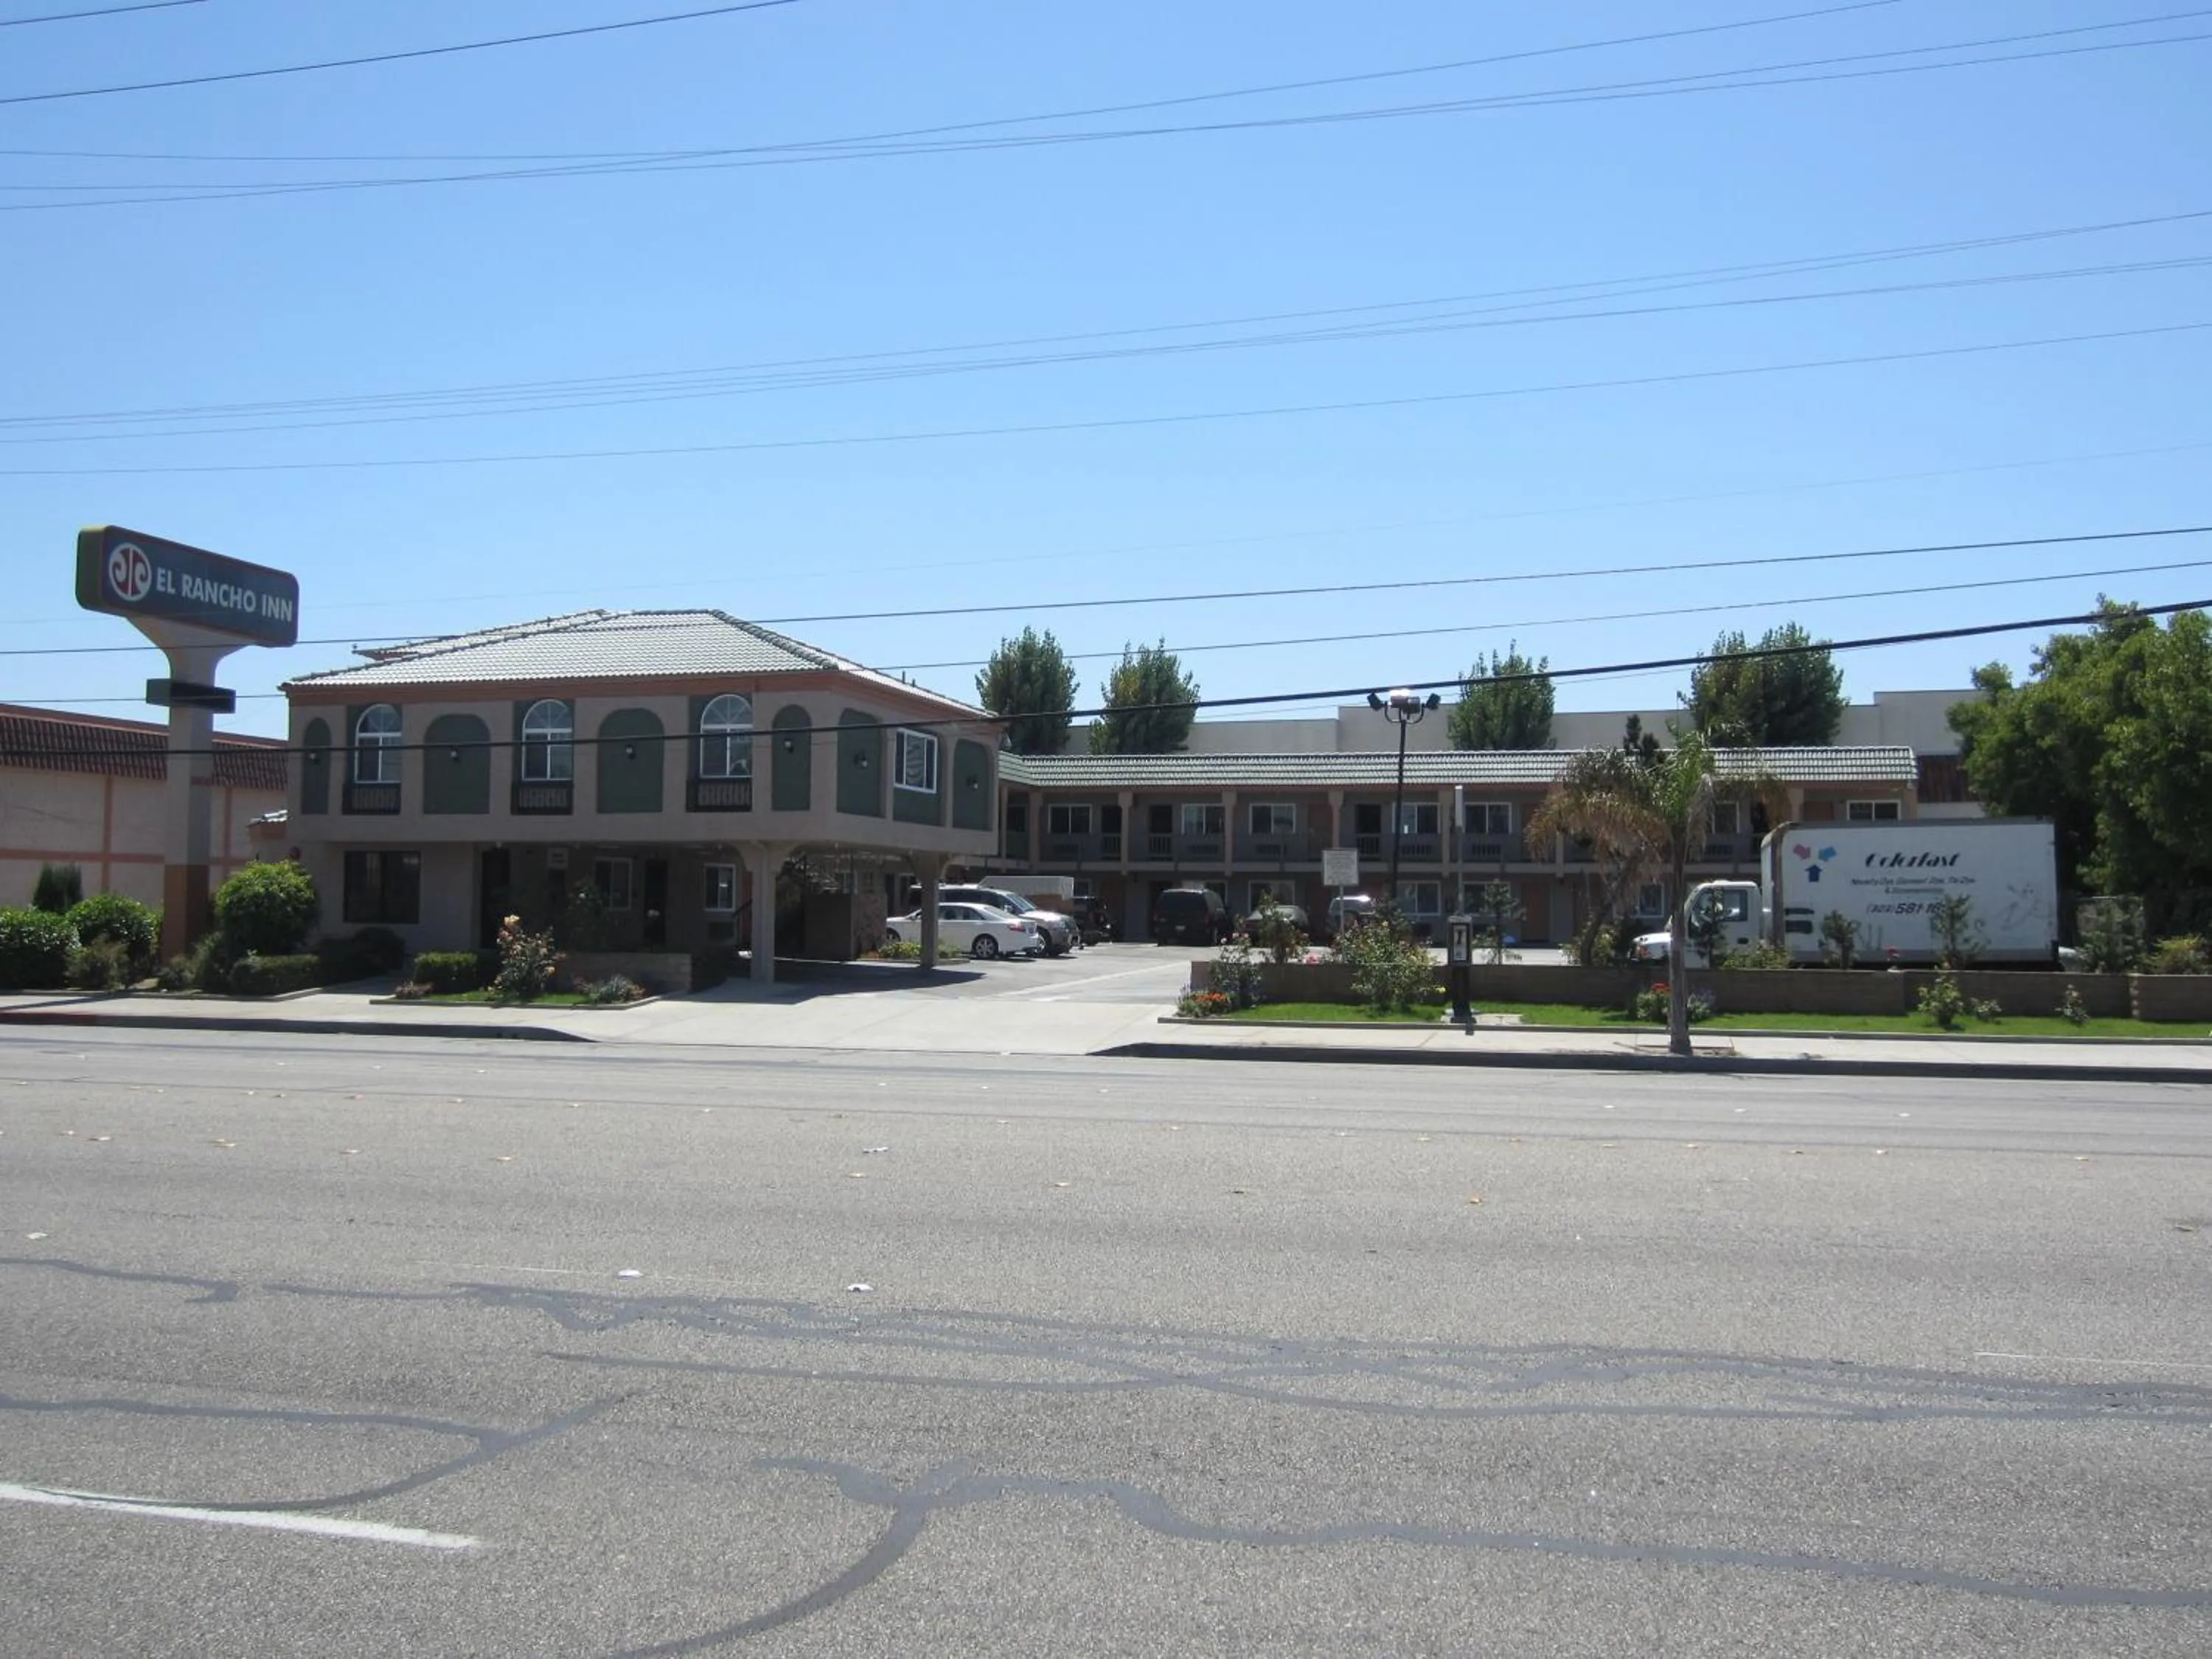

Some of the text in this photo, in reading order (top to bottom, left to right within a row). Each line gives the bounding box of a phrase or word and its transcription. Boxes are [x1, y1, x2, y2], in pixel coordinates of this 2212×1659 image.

[156, 567, 293, 622] EL RANCHO INN
